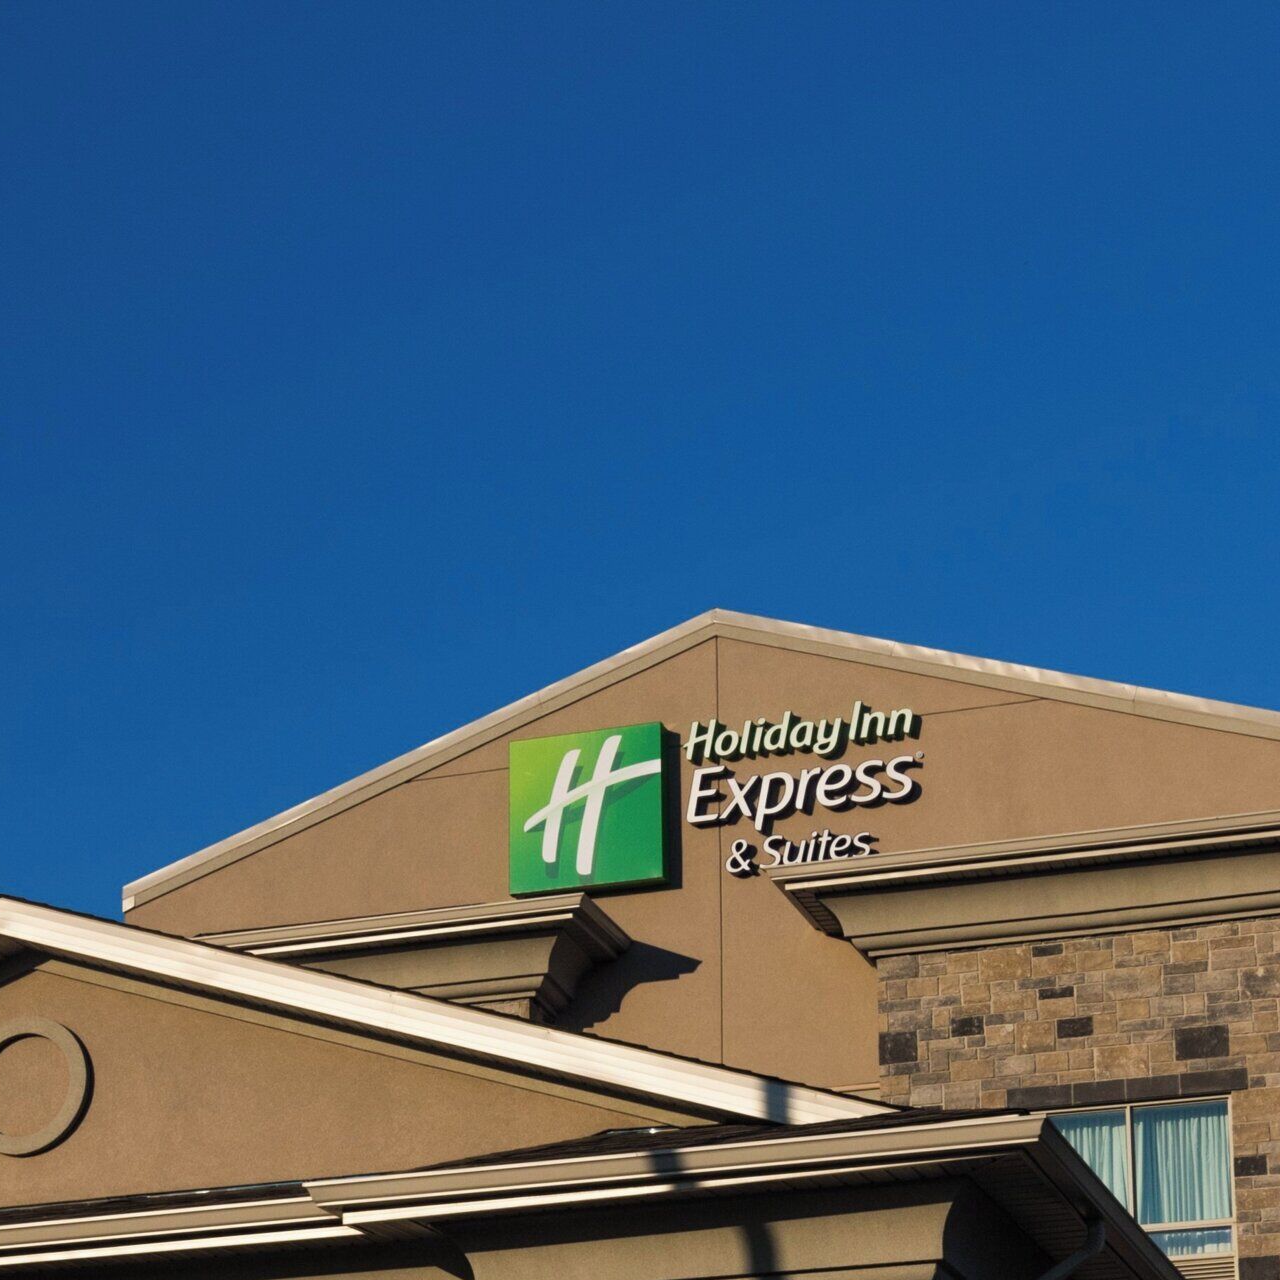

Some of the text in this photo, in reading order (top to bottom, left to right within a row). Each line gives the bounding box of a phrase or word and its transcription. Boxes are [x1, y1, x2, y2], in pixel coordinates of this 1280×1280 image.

[683, 701, 913, 760] Holiday Inn
[687, 756, 914, 831] Express
[725, 829, 870, 873] & Suites
